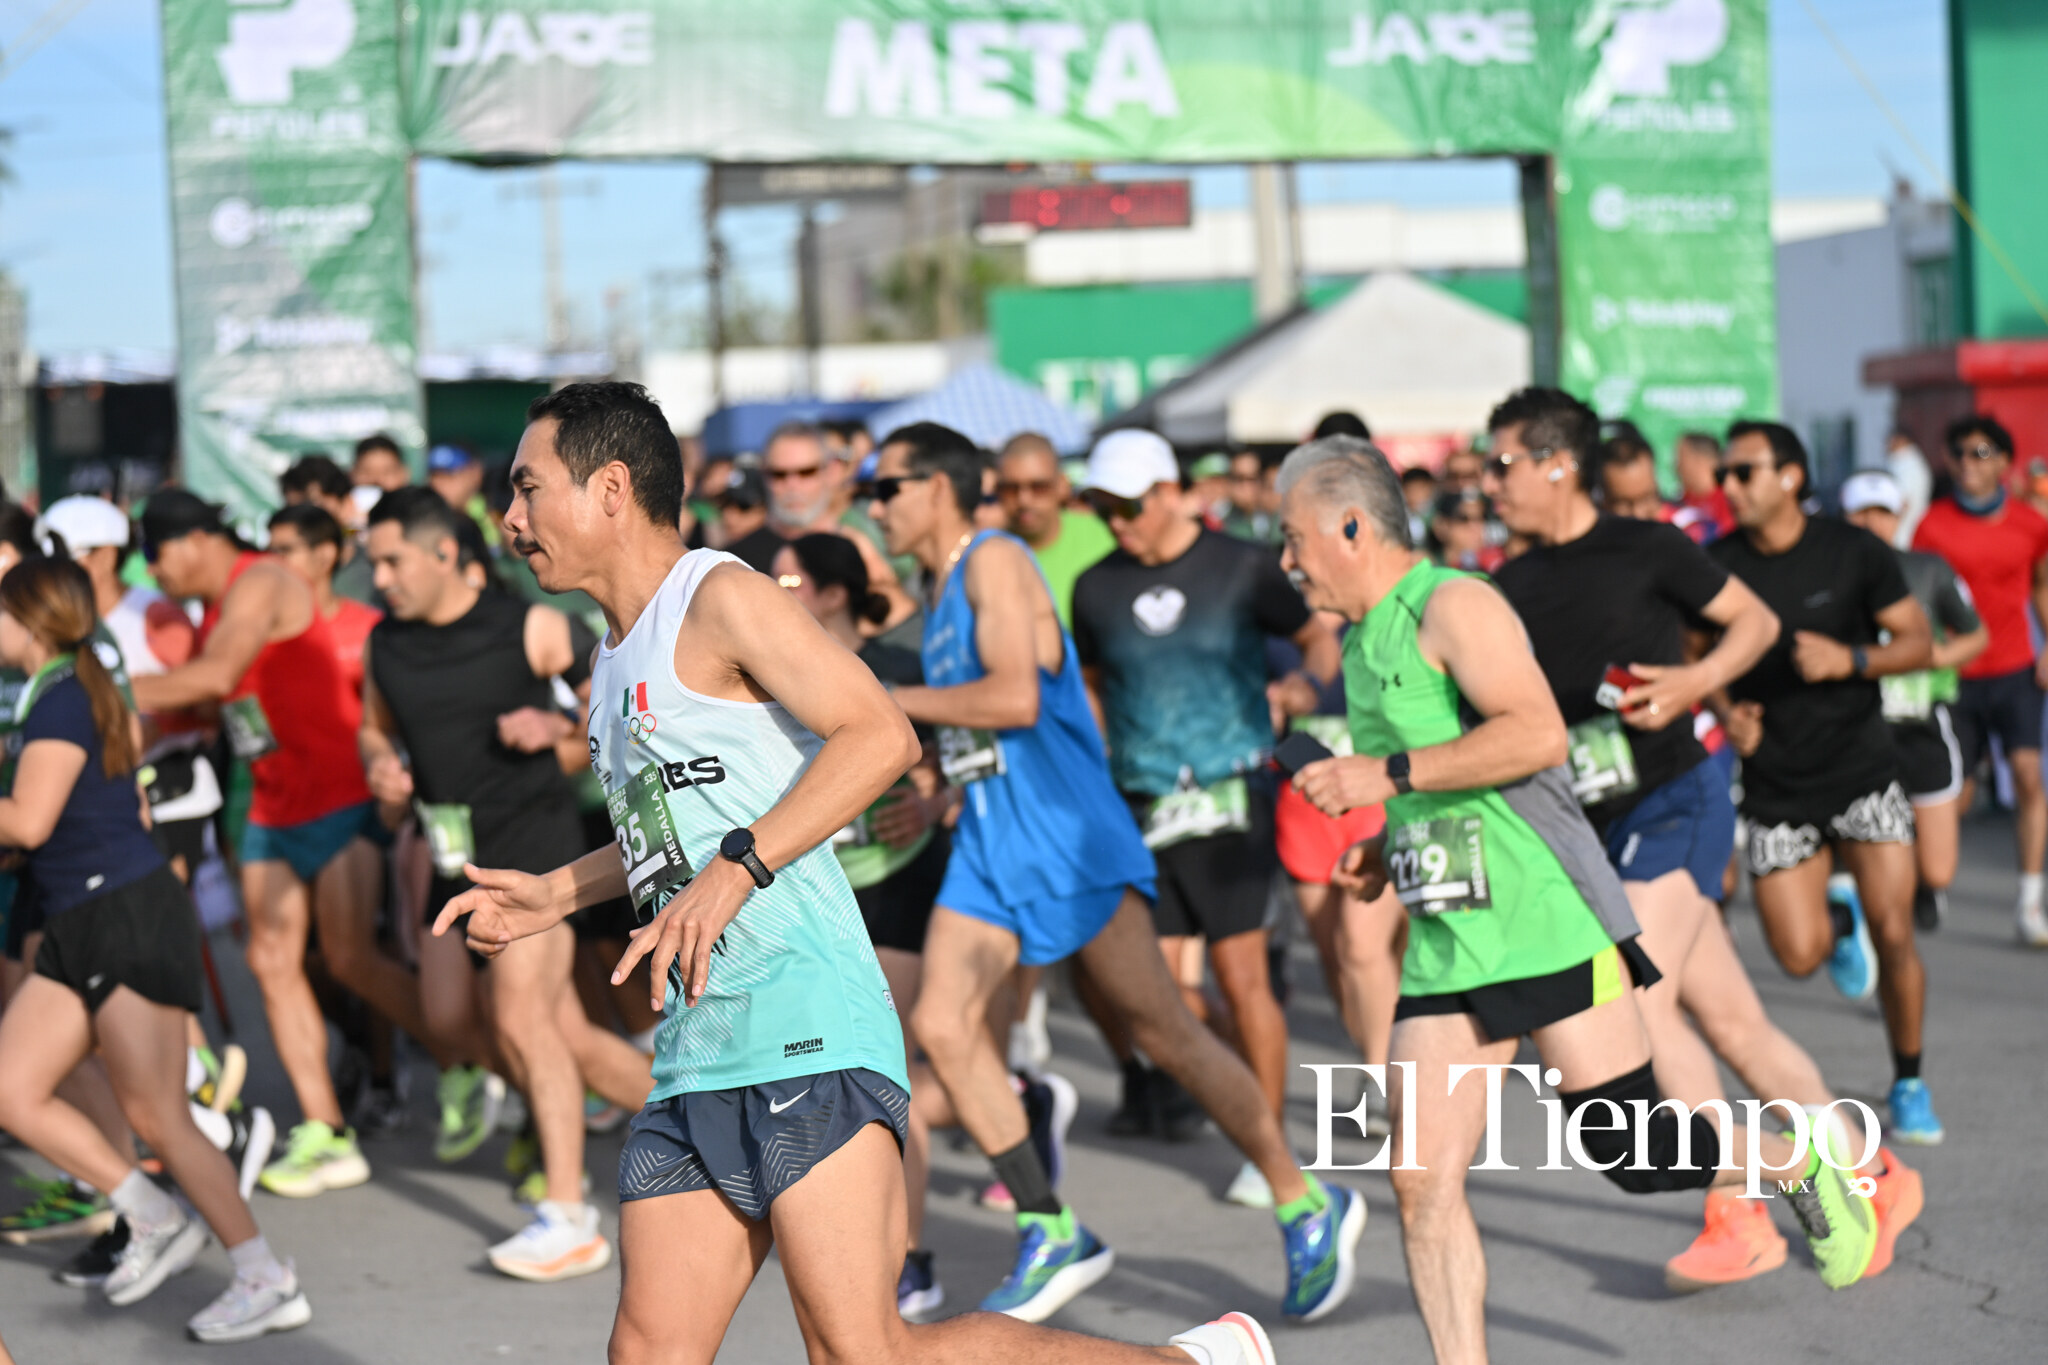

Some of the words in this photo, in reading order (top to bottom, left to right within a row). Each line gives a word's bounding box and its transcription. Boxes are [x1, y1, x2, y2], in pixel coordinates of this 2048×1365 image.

[825, 18, 1182, 118] META
[644, 771, 657, 786] 535
[651, 789, 683, 866] MEDALLA
[1390, 843, 1448, 890] 229
[784, 1037, 823, 1053] MARIN
[784, 1046, 824, 1058] SPORTSWEAR
